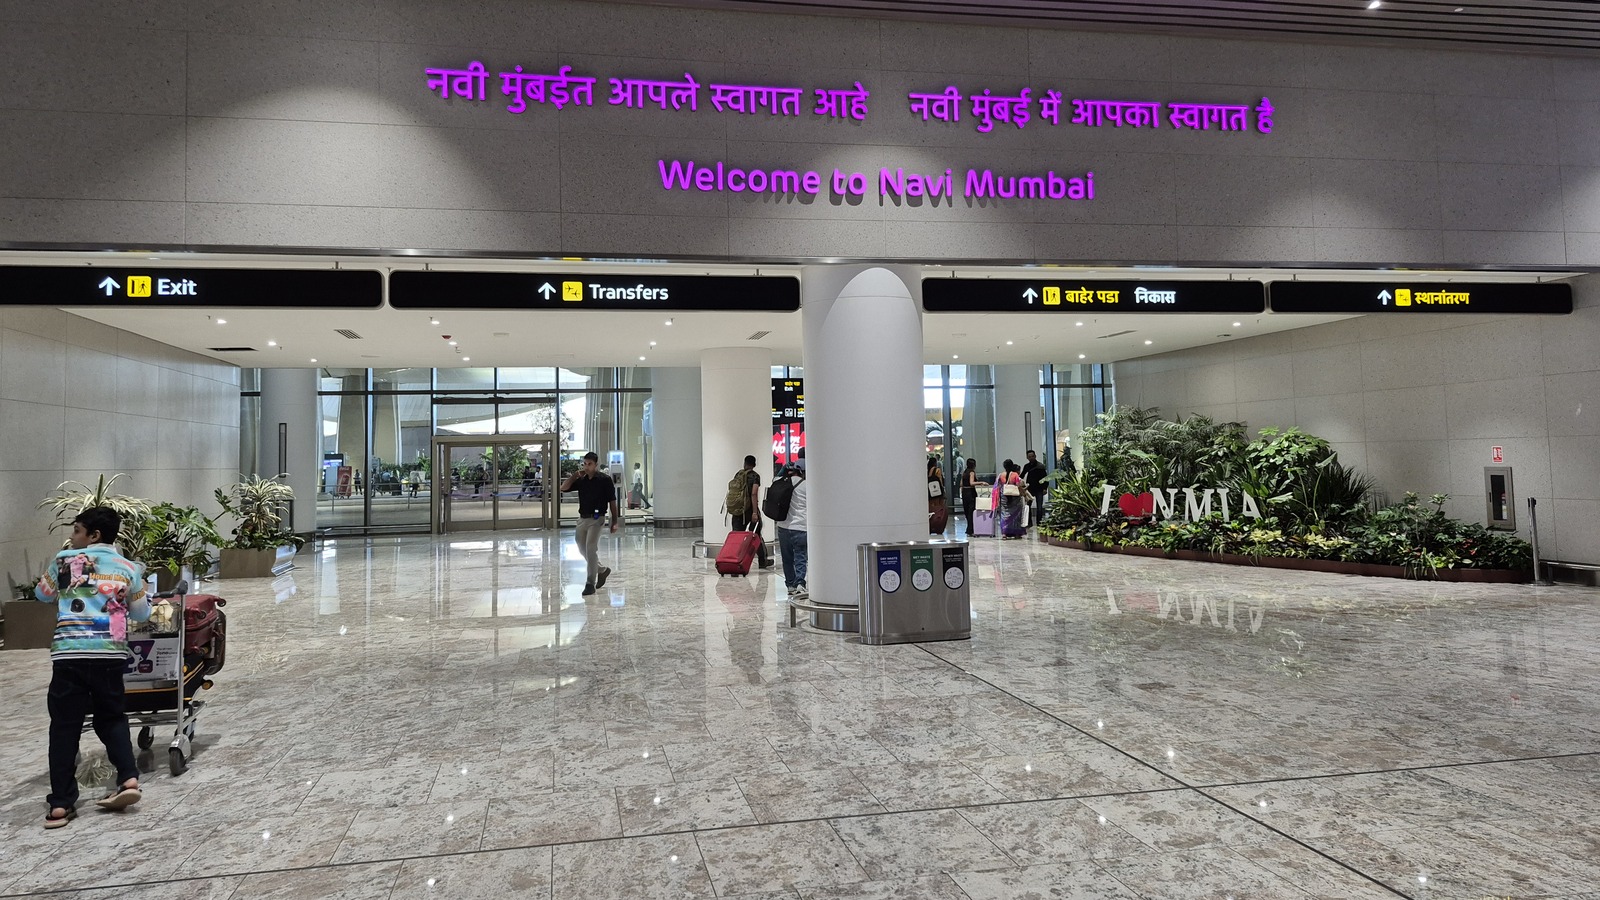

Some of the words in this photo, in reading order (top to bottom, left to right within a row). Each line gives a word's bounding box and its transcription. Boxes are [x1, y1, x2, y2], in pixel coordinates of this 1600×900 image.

[425, 61, 490, 101] नवी
[499, 65, 597, 114] मुंबईत
[608, 73, 701, 111] आपले
[710, 84, 803, 116] स्वागत
[814, 81, 870, 120] आहे
[909, 86, 963, 122] नवी
[970, 88, 1032, 133] मुंबई
[1039, 89, 1062, 125] में
[1071, 99, 1161, 128] आपका
[1168, 102, 1249, 131] स्वागत
[1255, 97, 1275, 133] है
[658, 159, 821, 194] Welcome
[833, 168, 867, 196] to
[879, 167, 953, 198] Navi
[964, 169, 1095, 200] Mumbai
[157, 278, 198, 296] Exit
[588, 283, 669, 301] Transfers
[1065, 286, 1095, 304] बाहेर
[1096, 290, 1120, 304] पडा
[1134, 286, 1176, 304] निकास
[1414, 289, 1470, 305] स्थानांतरण
[1101, 484, 1115, 515] I
[1150, 487, 1263, 522] NMIA
